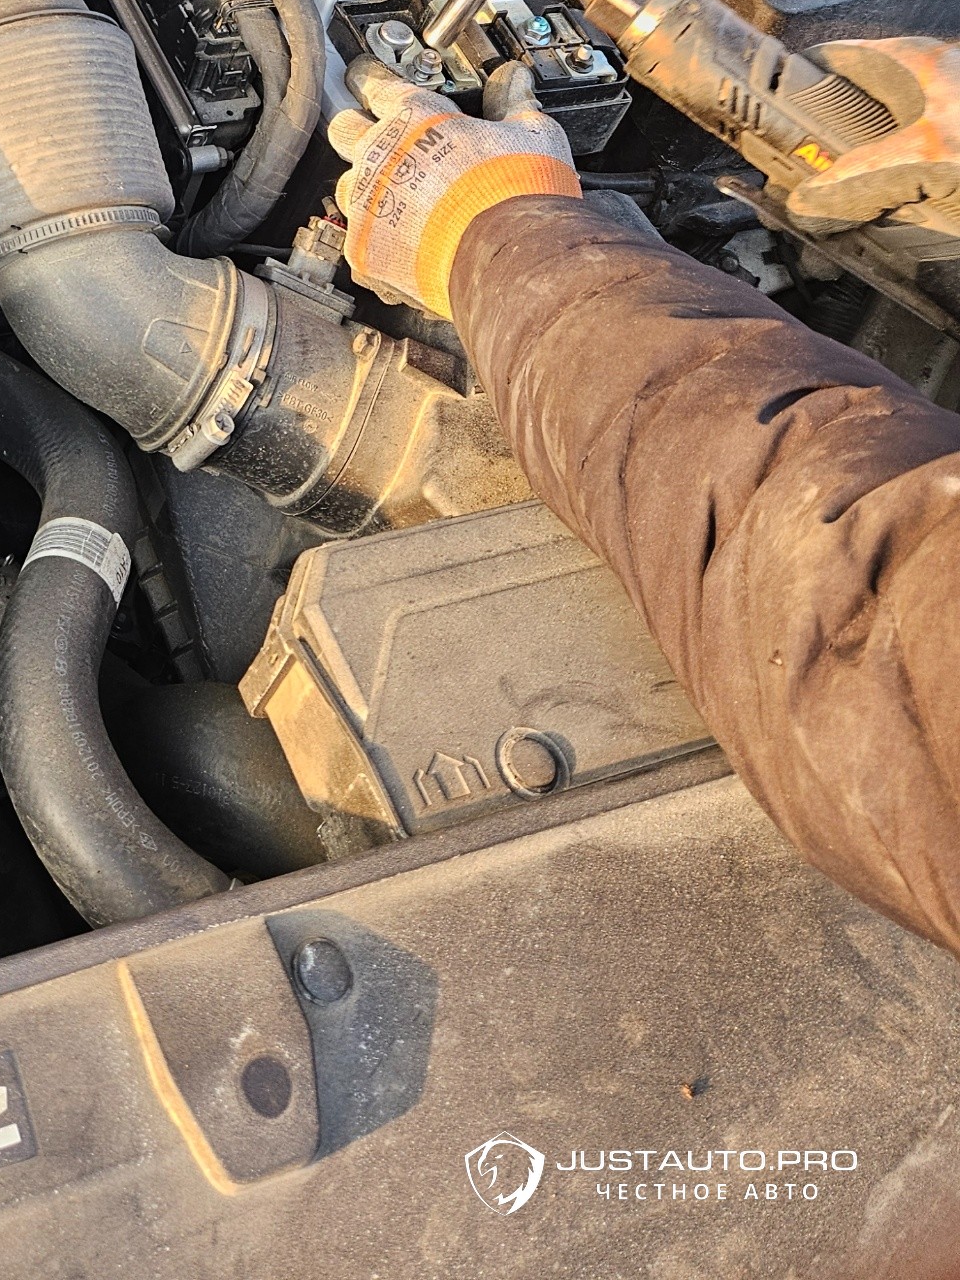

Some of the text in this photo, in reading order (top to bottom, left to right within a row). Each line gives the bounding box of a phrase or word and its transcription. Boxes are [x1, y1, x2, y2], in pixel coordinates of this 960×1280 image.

[366, 118, 407, 163] BEST
[414, 127, 444, 154] M
[431, 141, 457, 163] SIZE
[409, 171, 426, 190] 010
[389, 201, 407, 228] 2243
